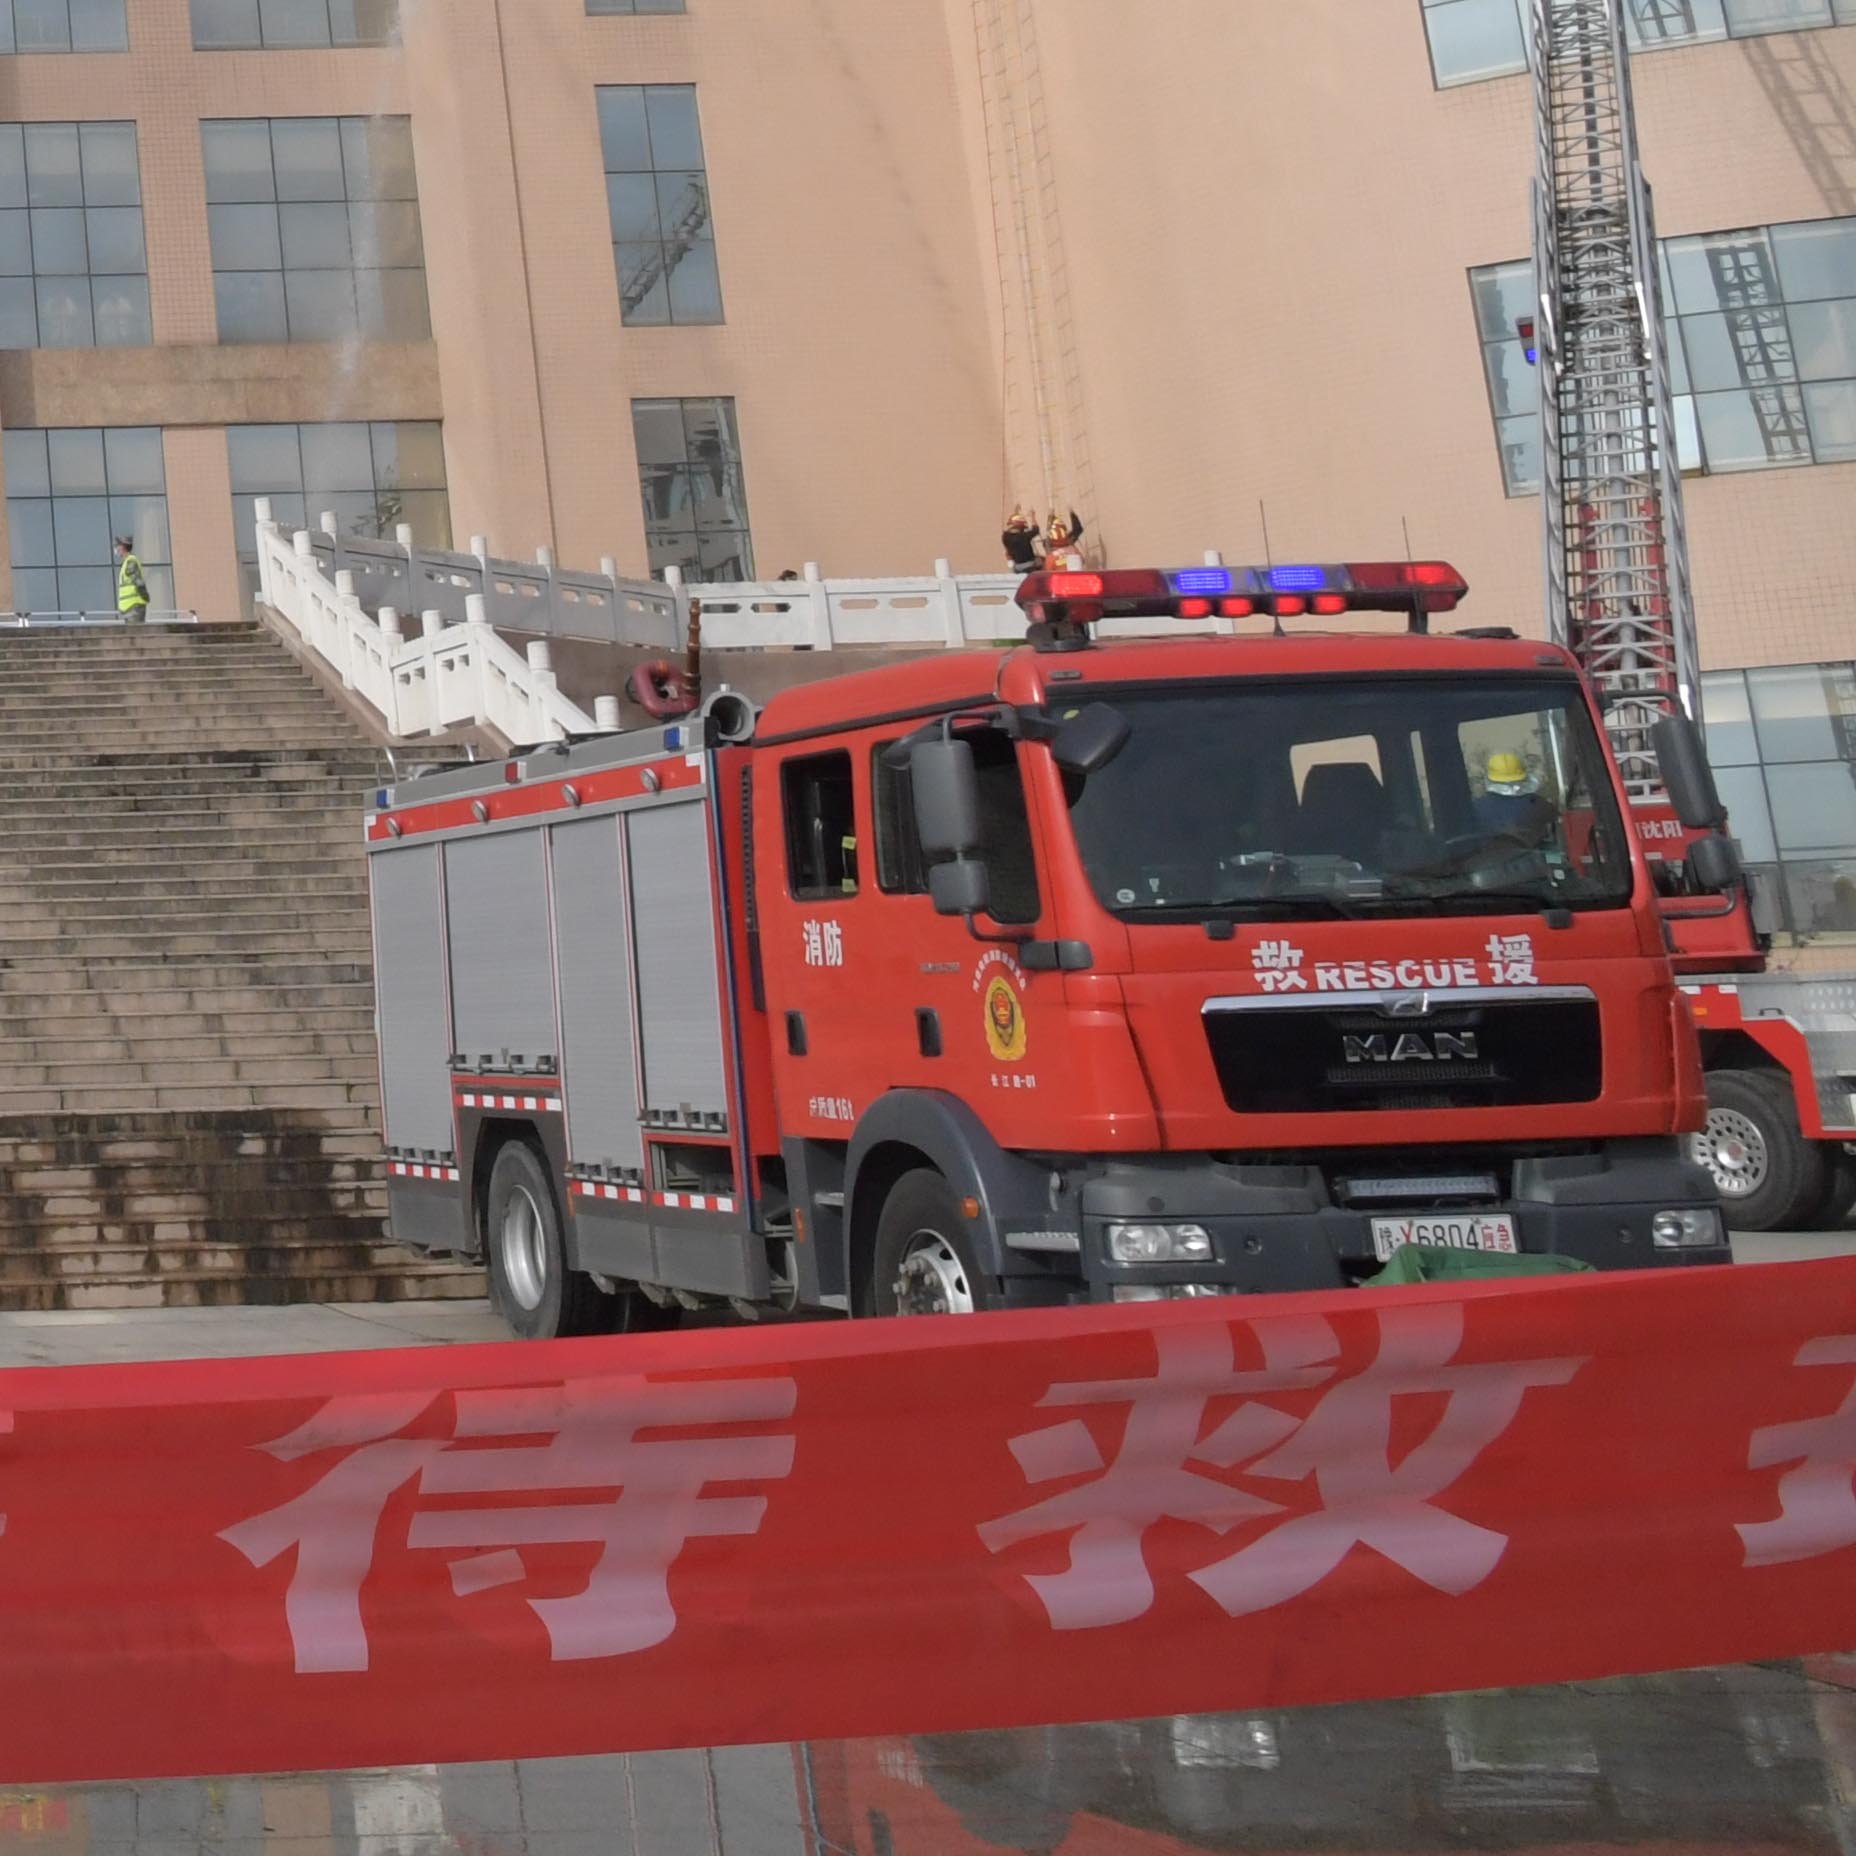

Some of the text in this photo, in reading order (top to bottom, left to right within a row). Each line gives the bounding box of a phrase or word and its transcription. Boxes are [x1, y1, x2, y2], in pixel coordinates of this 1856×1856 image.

[1635, 820, 1684, 840] 沈阳
[802, 919, 844, 967] 消防
[1251, 933, 1540, 992] 救 RESCUE 援
[1342, 1031, 1479, 1063] MAN
